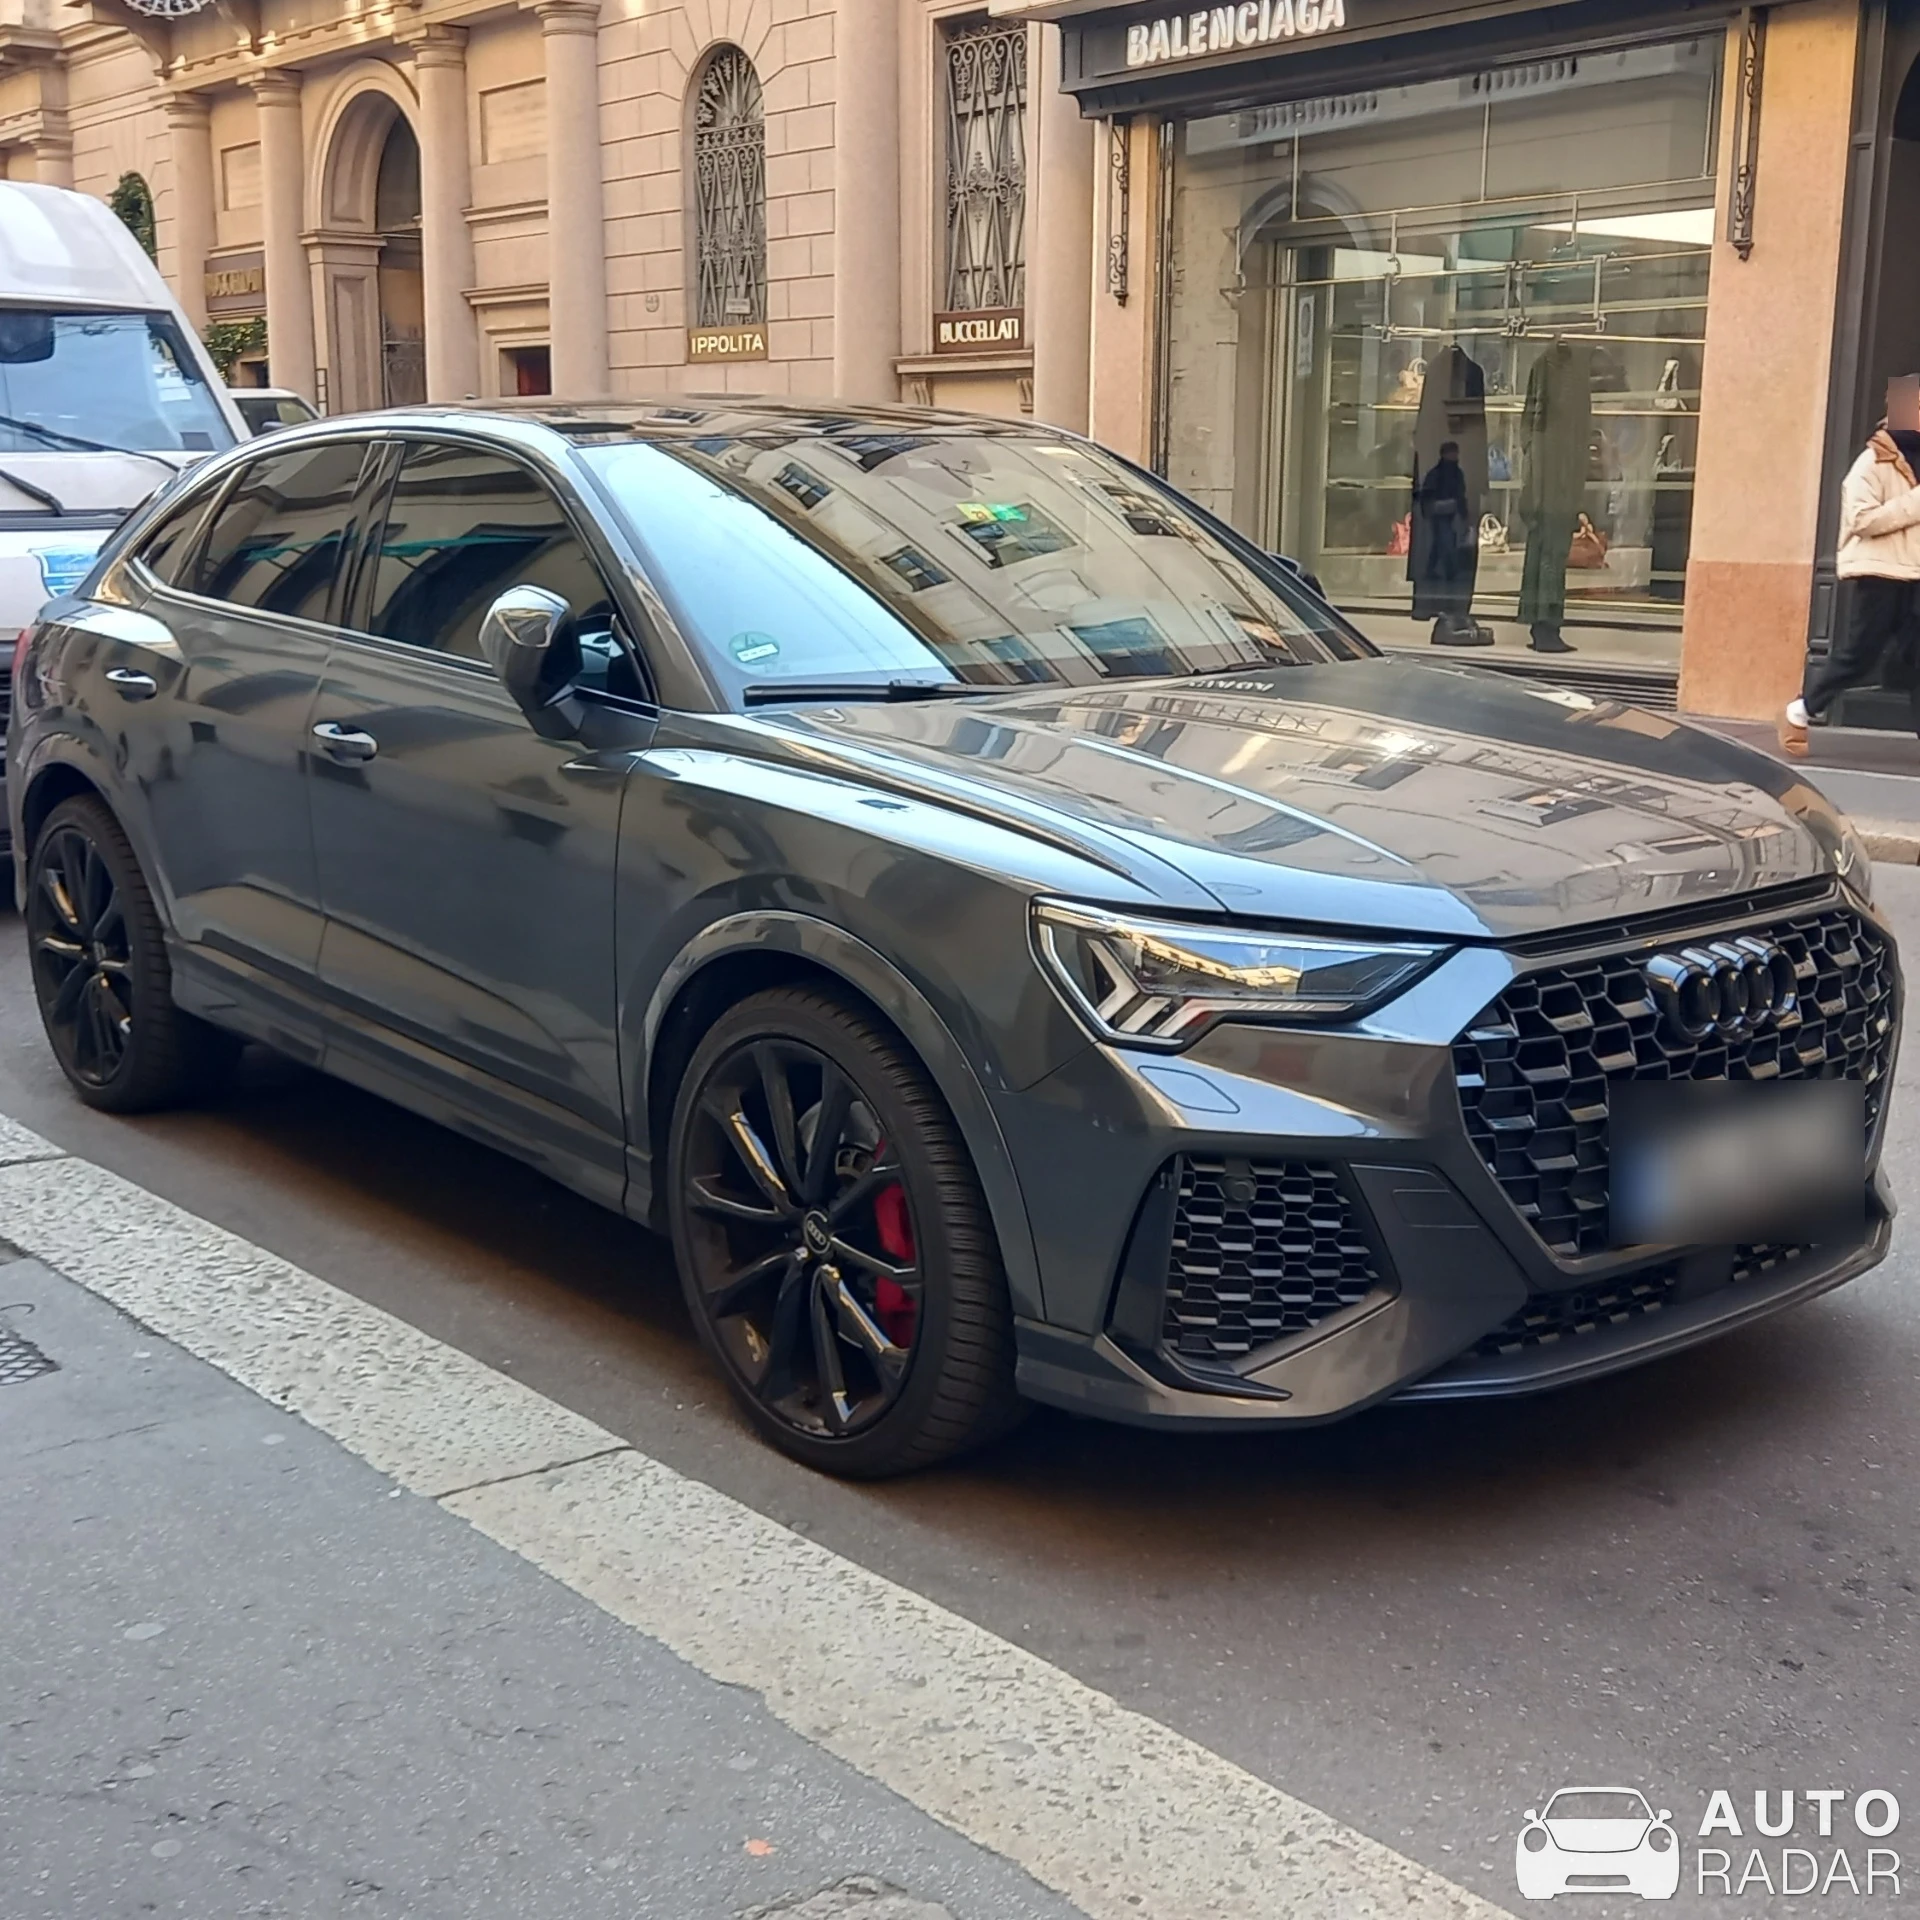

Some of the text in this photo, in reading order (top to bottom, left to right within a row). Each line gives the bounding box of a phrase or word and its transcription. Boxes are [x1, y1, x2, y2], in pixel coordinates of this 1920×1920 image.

[1127, 0, 1345, 66] BALENCIAGA
[940, 318, 1019, 343] BUCCELLATI
[691, 333, 765, 354] IPPOLITA
